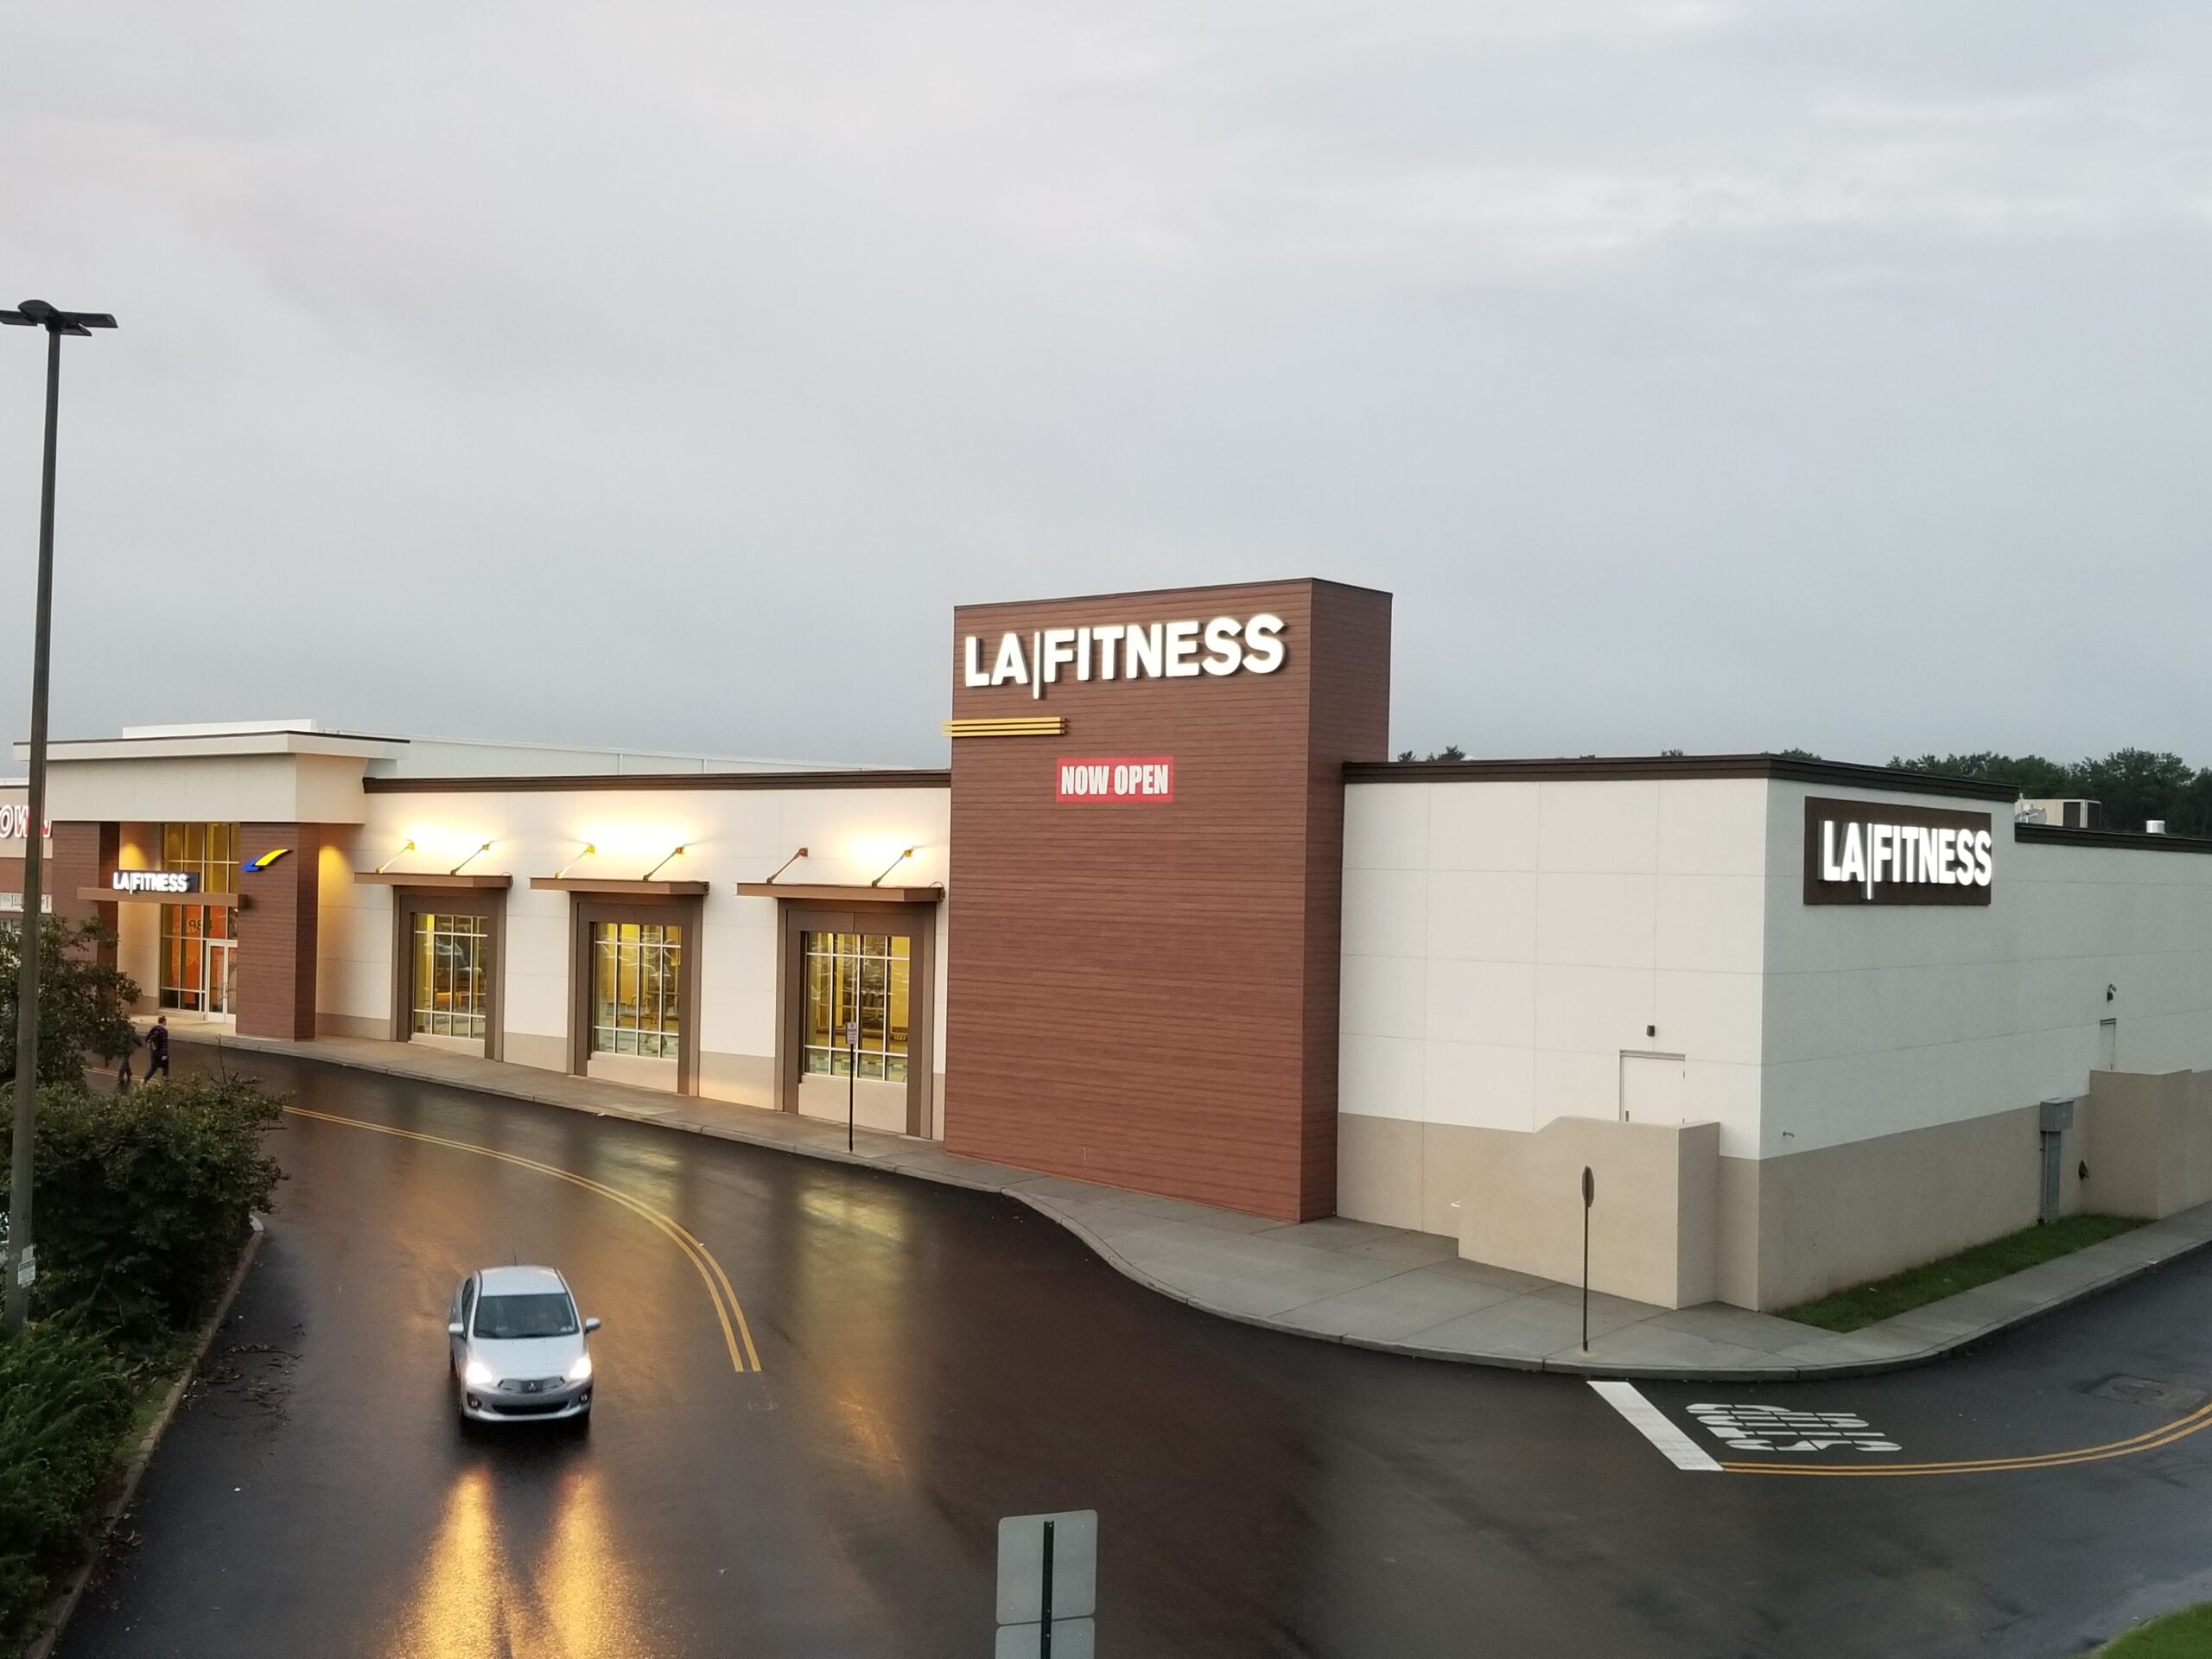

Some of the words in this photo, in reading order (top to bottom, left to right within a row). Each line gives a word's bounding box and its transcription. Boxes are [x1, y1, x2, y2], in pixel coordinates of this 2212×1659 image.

[964, 632, 1031, 687] LA
[1043, 614, 1287, 683] FITNESS
[1061, 766, 1109, 795] NOW
[1115, 765, 1168, 795] OPEN
[0, 804, 53, 838] OW
[1822, 820, 1865, 882] LA
[1873, 823, 1992, 887] FITNESS
[113, 872, 130, 890] LA
[132, 873, 188, 893] FITNESS
[1685, 1403, 1902, 1452] STOP
